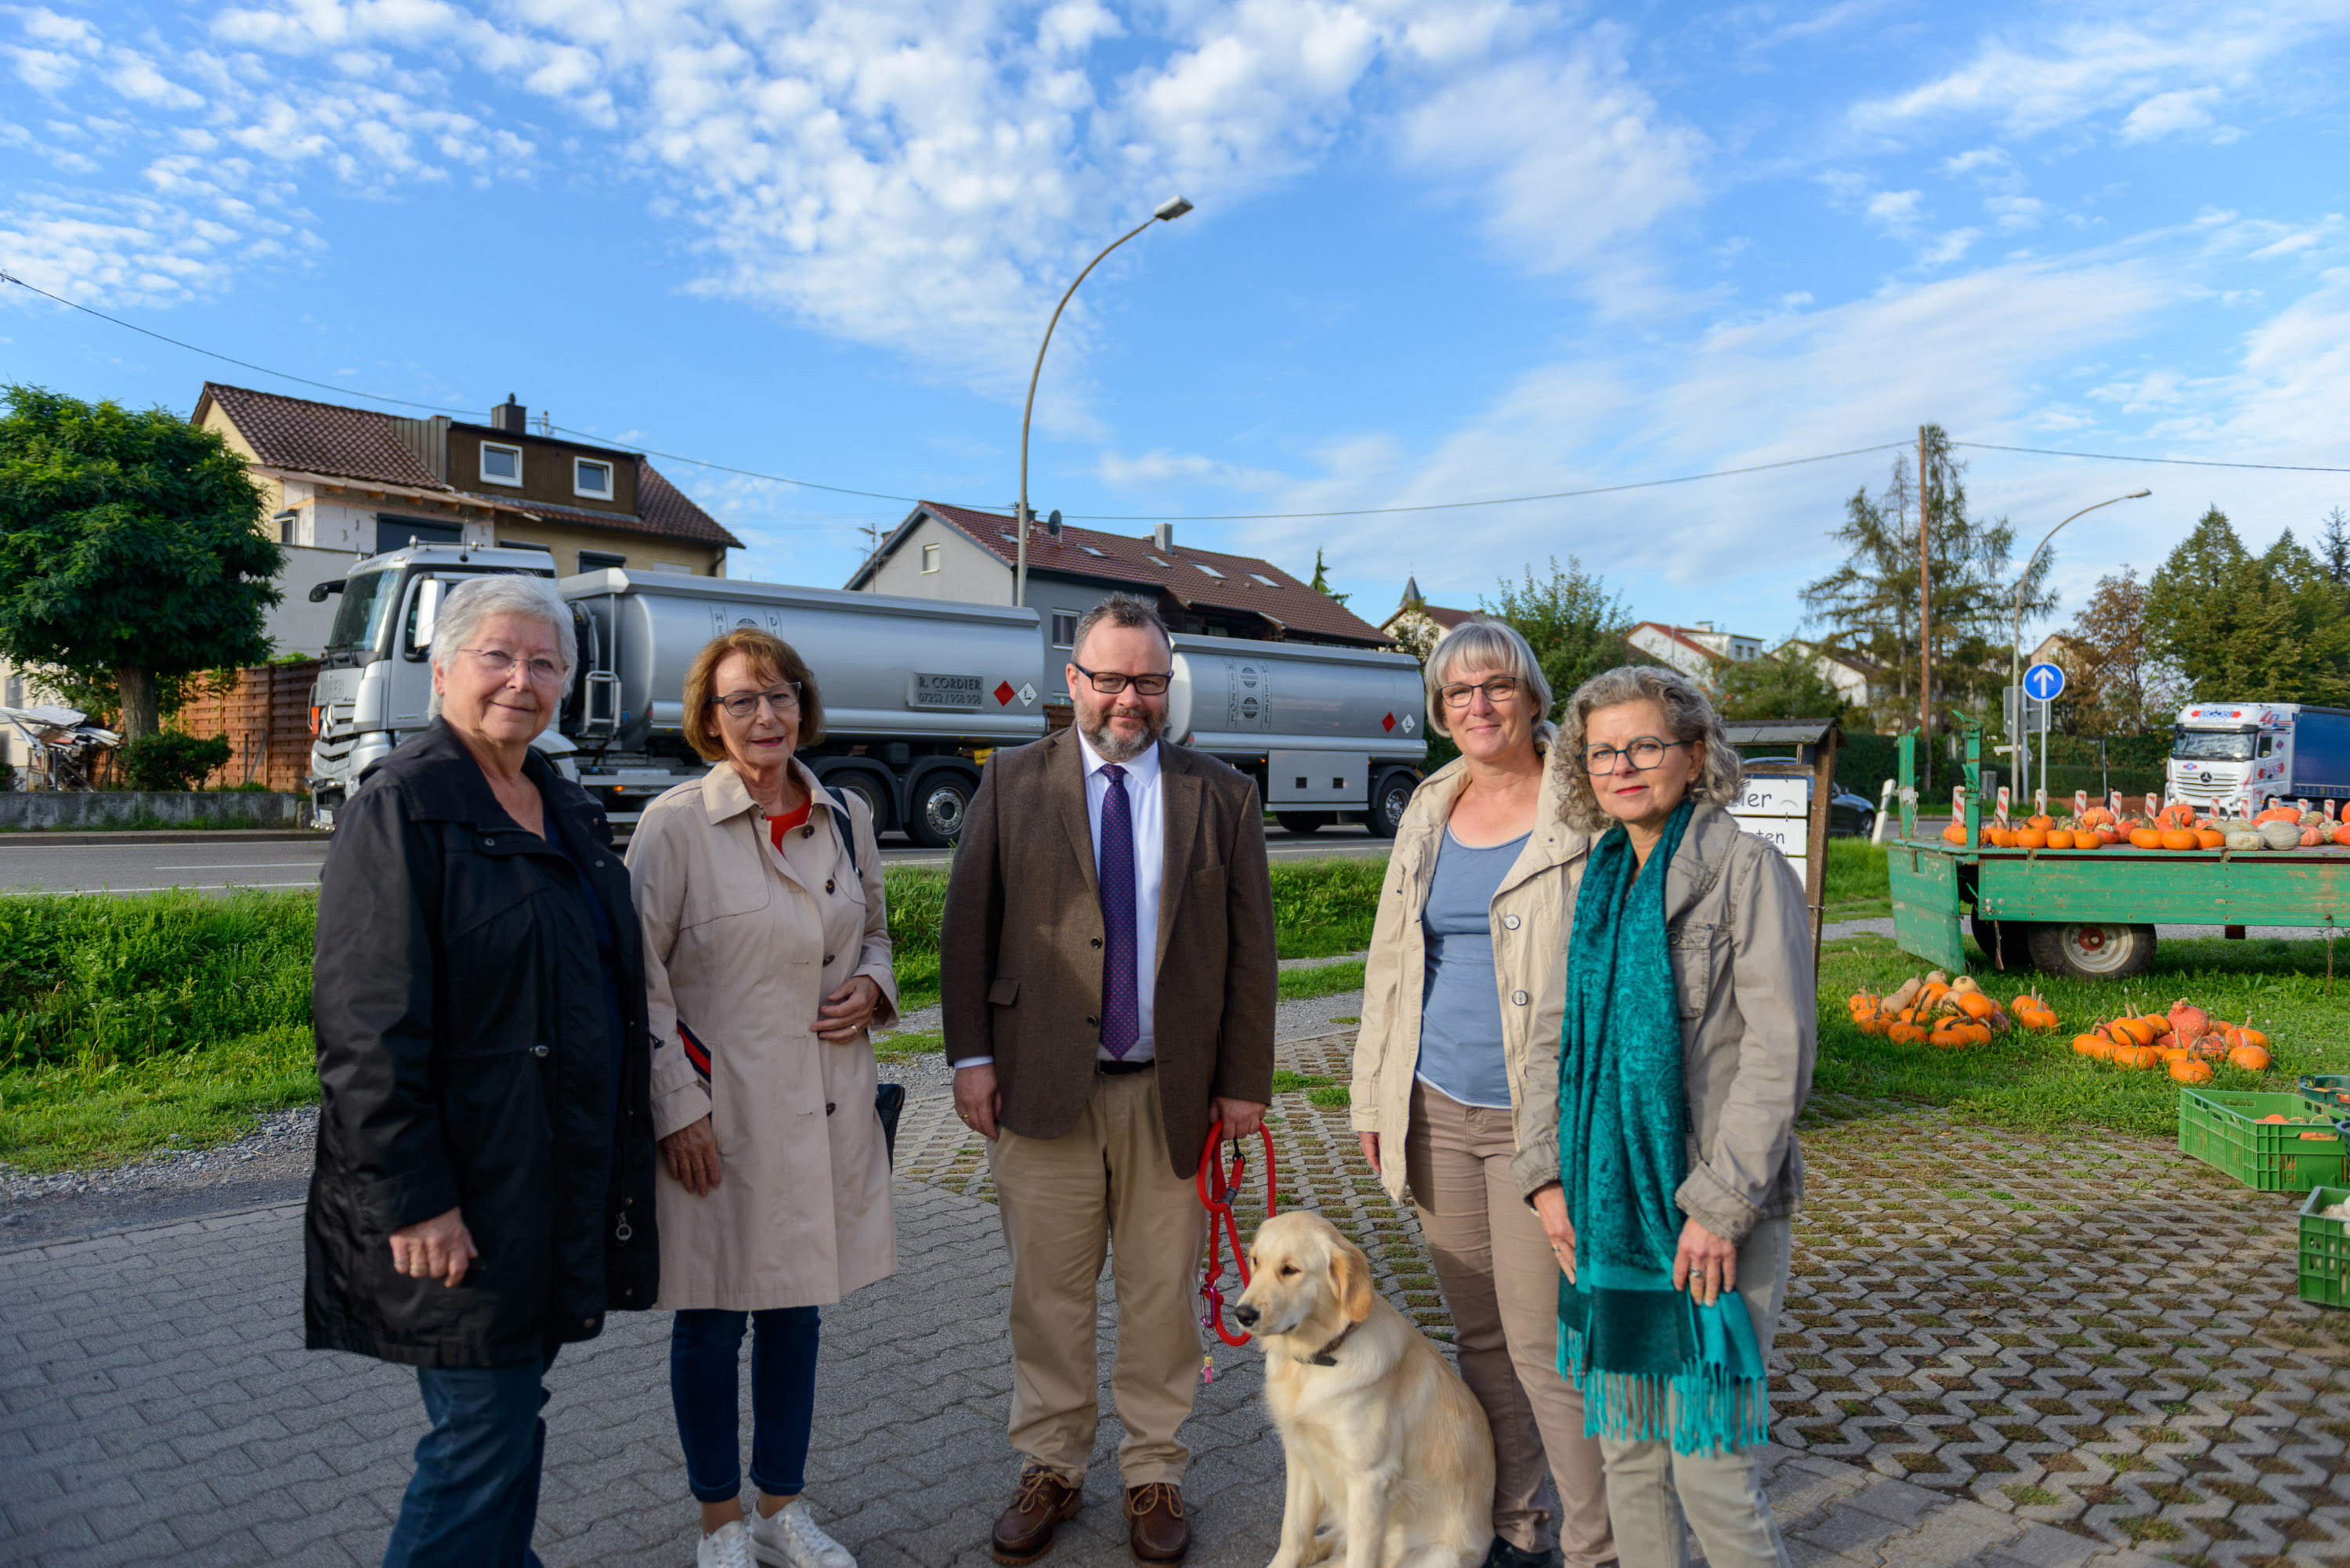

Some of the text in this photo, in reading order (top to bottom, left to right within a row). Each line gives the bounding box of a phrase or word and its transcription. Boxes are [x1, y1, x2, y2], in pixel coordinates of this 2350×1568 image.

[919, 676, 981, 690] R. CORDIER
[919, 692, 943, 703] 07252
[950, 694, 965, 703] 958
[967, 695, 982, 704] 958
